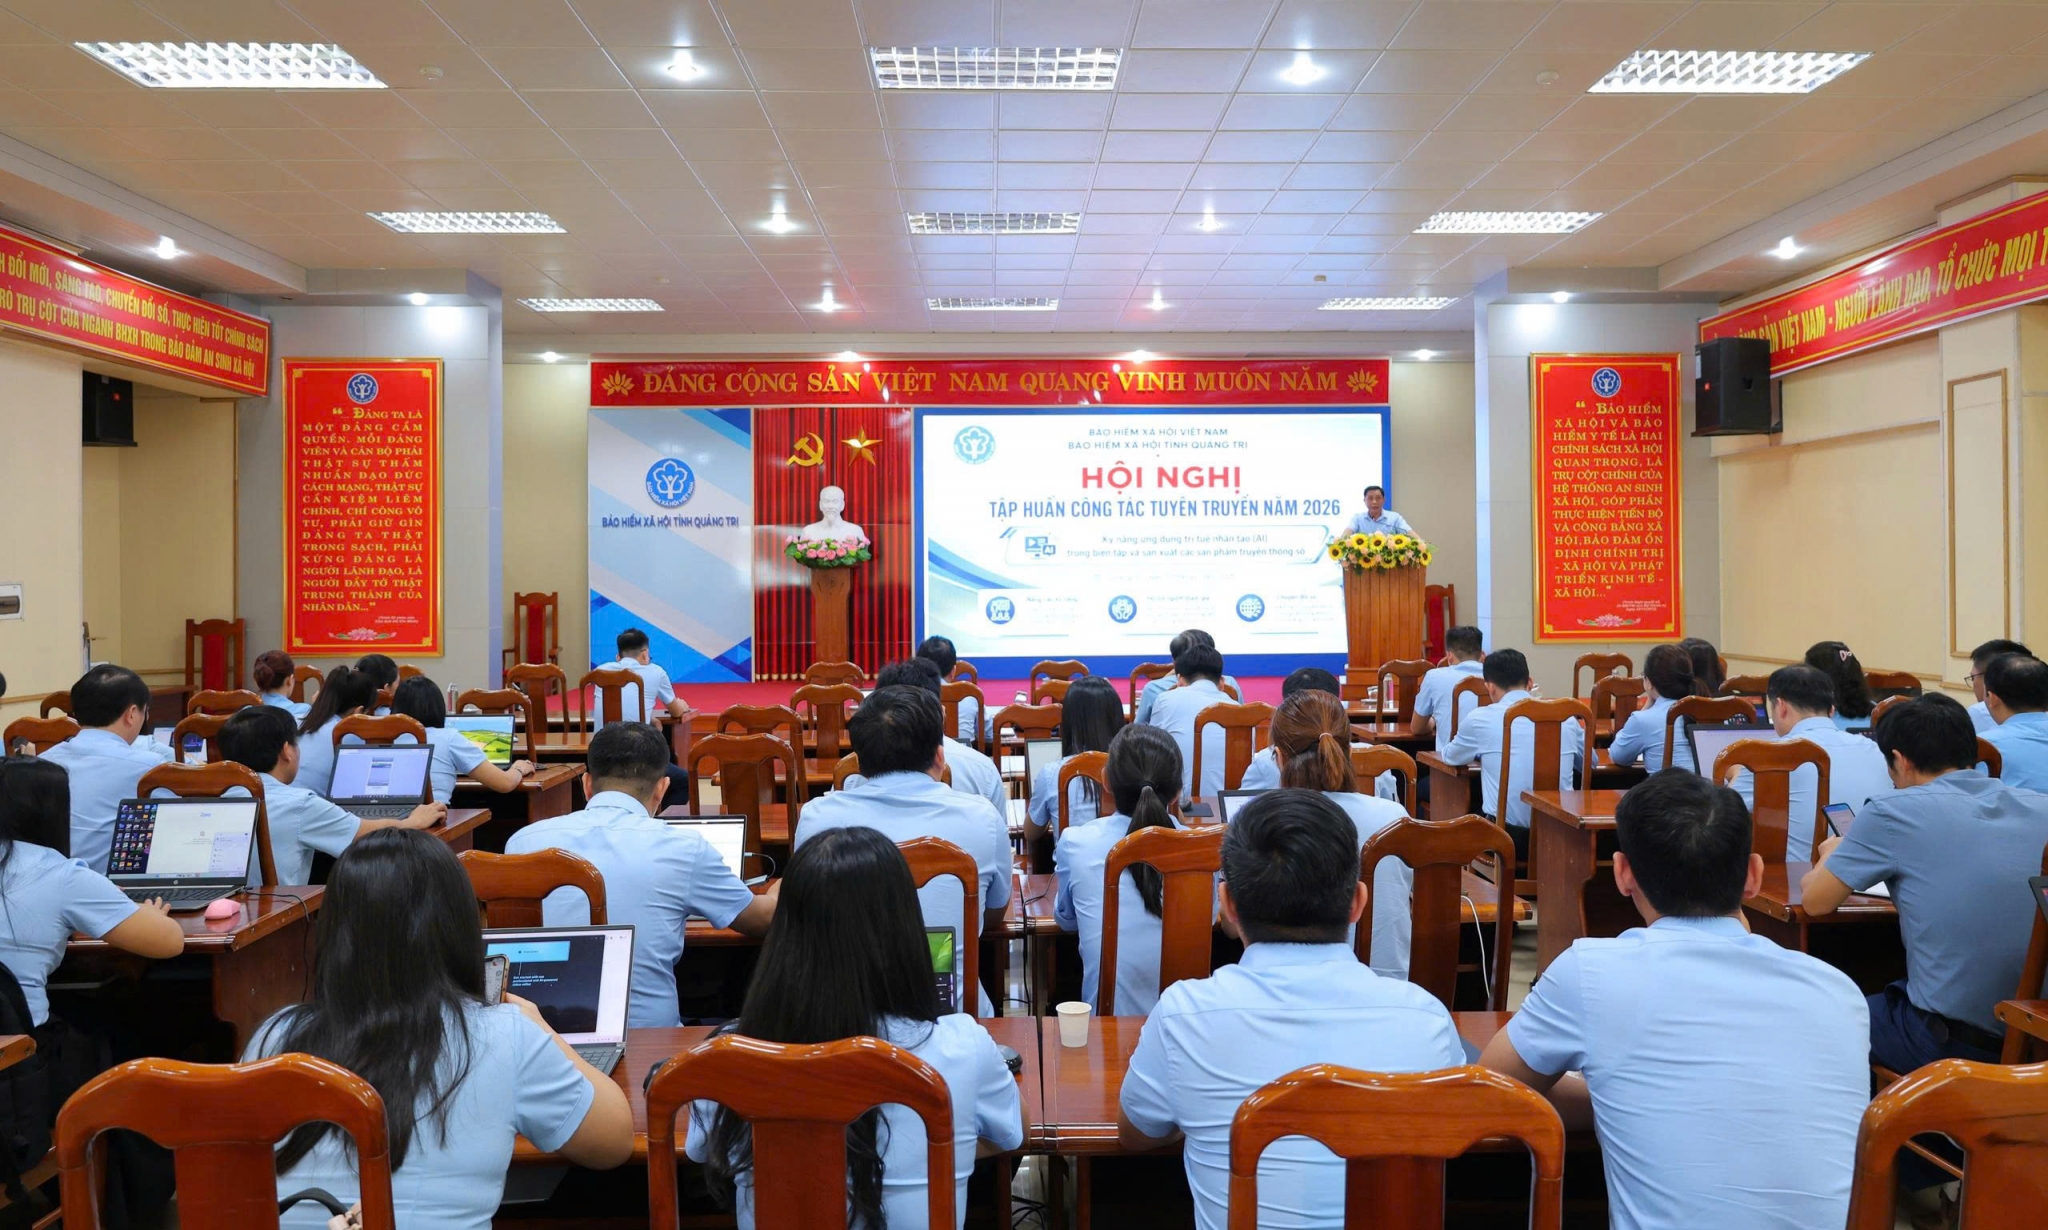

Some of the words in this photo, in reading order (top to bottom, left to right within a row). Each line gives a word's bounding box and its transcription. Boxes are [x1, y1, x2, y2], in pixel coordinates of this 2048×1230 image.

[1779, 310, 1799, 354] VIỆT
[1801, 305, 1826, 343] NAM
[1835, 283, 1869, 333] NGƯỜI
[1871, 277, 1903, 320] LÃNH
[1904, 267, 1931, 313] ĐẠO,
[1936, 242, 1957, 297] TỔ
[1954, 238, 1999, 290] CHỨC
[2000, 231, 2038, 281] MỌI
[8, 251, 26, 279] ĐỔI
[30, 262, 52, 290] MỚI,
[55, 270, 81, 293] SÁNG
[84, 281, 103, 305] TẠO,
[106, 288, 140, 315] CHUYỂN
[142, 296, 155, 320] ĐỔI
[158, 301, 170, 327] SỐ,
[172, 310, 191, 333] THỰC
[193, 316, 210, 339] HIỆN
[212, 319, 224, 342] TỐT
[225, 327, 245, 348] CHÍNH
[247, 333, 264, 354] SÁCH
[16, 293, 36, 321] TRỤ
[39, 298, 58, 325] CỘT
[61, 302, 79, 329] CỦA
[82, 313, 113, 339] NGÀNH
[116, 322, 138, 345] BHXH
[141, 330, 166, 354] TRONG
[168, 334, 184, 358] BẢO
[185, 340, 202, 363] ĐẢM
[204, 349, 214, 367] AN
[216, 352, 232, 372] SINH
[233, 356, 242, 375] XÃ
[244, 359, 255, 380] HỘI
[643, 367, 716, 393] ĐẢNG
[725, 368, 798, 397] CỘNG
[807, 365, 863, 392] SẢN
[871, 367, 937, 397] VIỆT
[949, 373, 1007, 392] NAM
[1020, 372, 1109, 396] QUANG
[1116, 372, 1186, 392] VINH
[1194, 366, 1270, 392] MUÔN
[1279, 366, 1338, 391] NĂM
[353, 408, 388, 419] ĐẢNG
[391, 411, 405, 419] TA
[1205, 428, 1228, 436] NAM
[1553, 429, 1586, 441] HIỂM
[1590, 432, 1598, 441] Y
[1601, 429, 1617, 441] TẾ
[1621, 430, 1637, 441] LÀ
[1640, 431, 1663, 441] HAI
[303, 447, 330, 455] VIÊN
[377, 448, 392, 458] BỘ
[396, 447, 423, 455] PHẢI
[1552, 444, 1589, 454] CHÍNH
[1592, 444, 1621, 454] SÁCH
[1624, 444, 1639, 453] XÃ
[1642, 442, 1663, 455] HỘI
[303, 458, 343, 469] THẬT
[352, 459, 372, 469] SỰ
[380, 457, 423, 467] THẤM
[1082, 460, 1143, 495] HỘI
[1158, 466, 1240, 494] NGHỊ
[1552, 471, 1574, 481] TRỤ
[1577, 469, 1599, 481] CỘT
[1601, 469, 1637, 479] CHÍNH
[1640, 468, 1663, 479] CỦA
[303, 482, 333, 491] CÁCH
[337, 484, 373, 493] MẠNG,
[375, 482, 405, 494] THẬT
[408, 483, 423, 494] SỰ
[1553, 482, 1569, 494] HỆ
[1572, 481, 1612, 493] THỐNG
[1616, 484, 1632, 493] AN
[1635, 484, 1663, 493] SINH
[990, 497, 1017, 522] TẬP
[1071, 497, 1112, 517] CÔNG
[1118, 496, 1144, 517] TÁC
[1151, 496, 1197, 516] TUYÊN
[1264, 496, 1298, 516] NĂM
[1303, 499, 1340, 515] 2026
[1552, 510, 1584, 520] THỰC
[1587, 508, 1616, 520] HIỆN
[1618, 507, 1644, 518] TIẾN
[1648, 507, 1663, 520] BỘ
[331, 518, 362, 526] PHẢI
[399, 518, 423, 526] GÌN
[602, 514, 619, 528] BẢO
[622, 513, 641, 527] HIỂM
[644, 515, 656, 527] XÃ
[658, 515, 672, 529] HỘI
[673, 514, 692, 527] TỈNH
[695, 514, 724, 529] QUẢNG
[726, 517, 739, 529] TRỊ
[1554, 521, 1569, 532] VÀ
[1573, 521, 1607, 532] CÔNG
[1611, 519, 1644, 532] BẰNG
[1648, 522, 1663, 531] XÃ
[1253, 535, 1268, 543] (AI)
[303, 565, 339, 575] NGƯỜI
[343, 566, 374, 575] LÃNH
[379, 568, 405, 577] ĐẠO,
[408, 565, 423, 575] LÀ
[351, 589, 392, 599] THÀNH
[399, 589, 423, 599] CỦA
[303, 601, 334, 611] NHÂN
